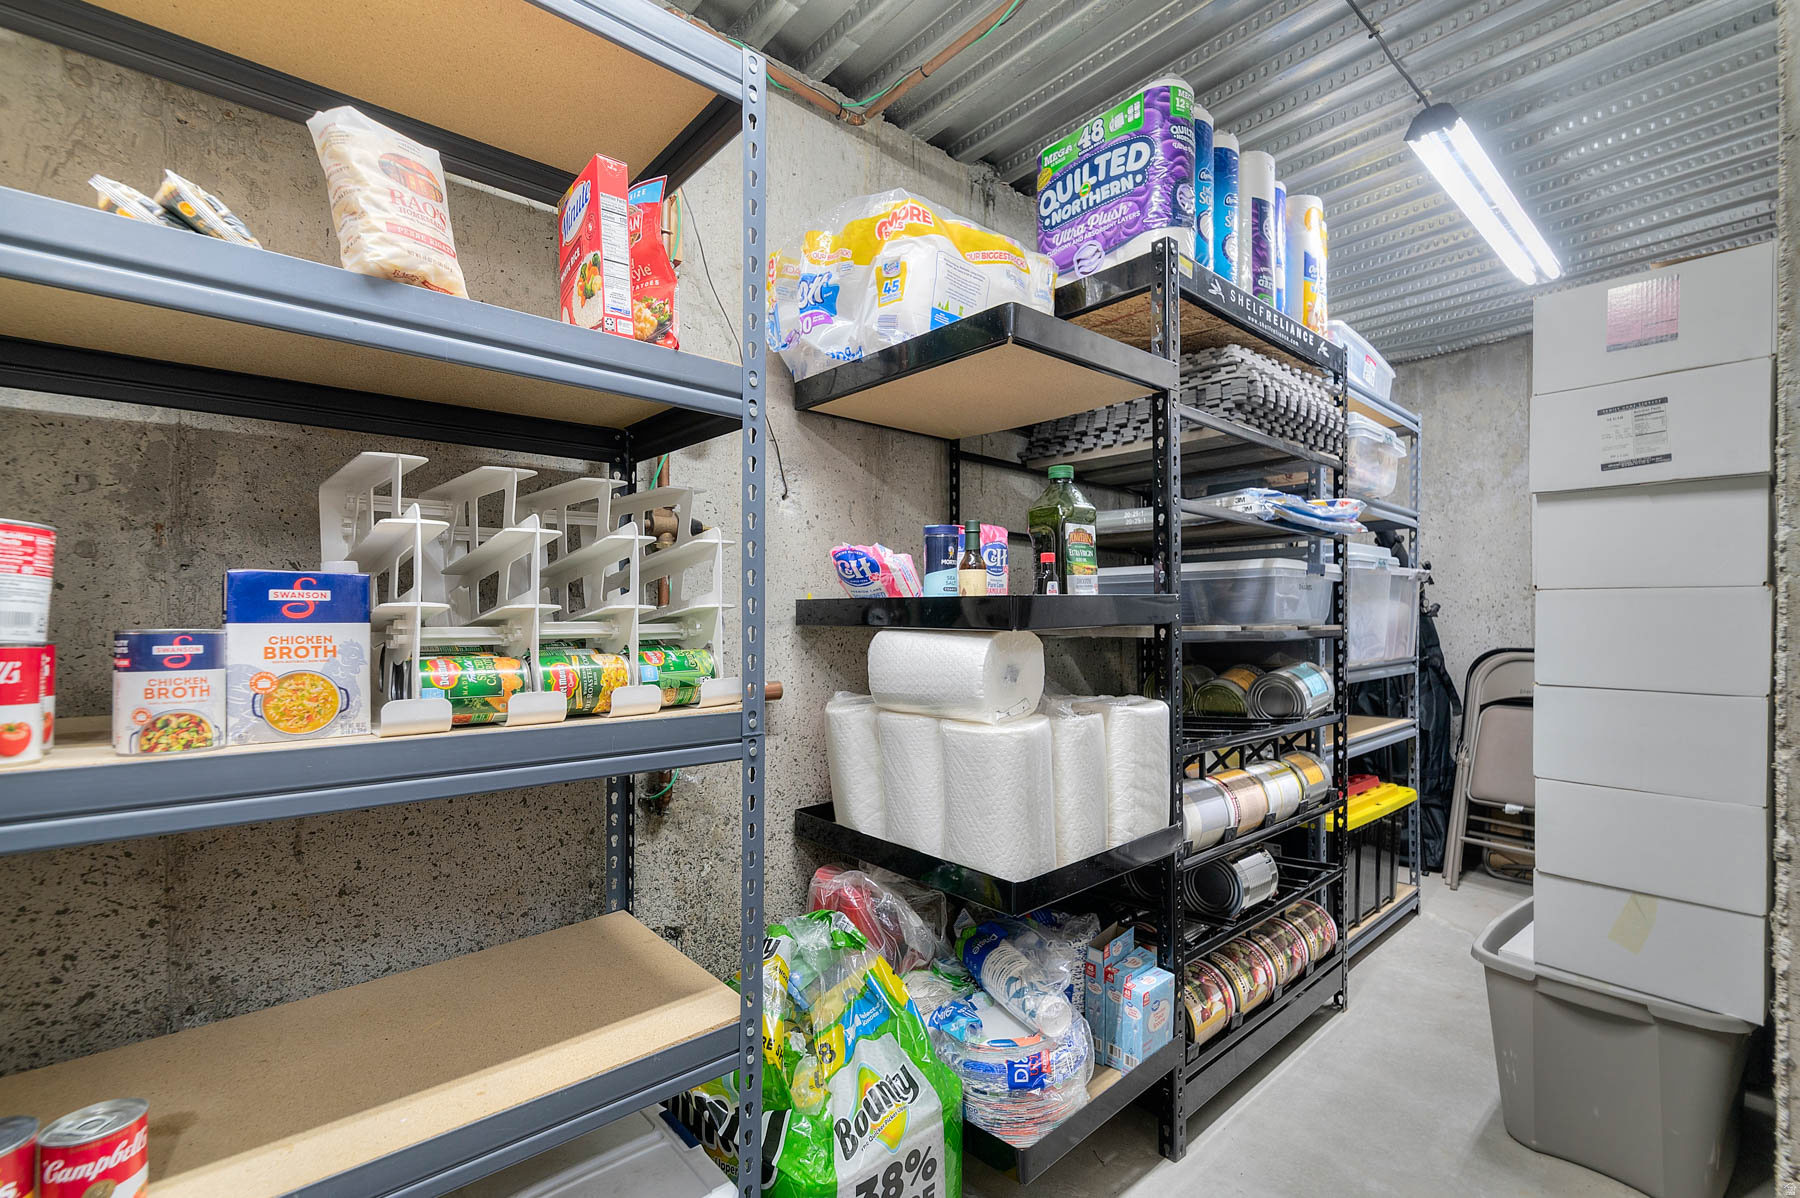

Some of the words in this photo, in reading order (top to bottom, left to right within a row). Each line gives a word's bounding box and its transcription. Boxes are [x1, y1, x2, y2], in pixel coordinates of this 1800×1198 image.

[1175, 97, 1185, 108] 12
[1076, 117, 1105, 148] 48
[1170, 126, 1195, 138] QUILT
[1044, 144, 1073, 167] MEGA
[1039, 141, 1151, 217] QUILTED
[629, 188, 647, 201] SIZE
[1051, 173, 1135, 226] NORTHERN
[388, 187, 447, 231] RAO'S
[563, 180, 591, 241] Minute
[1117, 210, 1141, 224] LAYERS
[1052, 222, 1087, 247] Ultra
[1087, 201, 1131, 231] Plush
[631, 263, 652, 282] tyle
[882, 279, 900, 295] 45
[1230, 289, 1315, 346] SHELFRELIANCE
[272, 591, 328, 600] SWANSON
[267, 635, 333, 646] CHICKEN
[155, 646, 202, 654] SWANSON
[263, 645, 338, 660] BROTH
[147, 676, 209, 688] CHICKEN
[143, 684, 211, 700] BROTH
[833, 1063, 920, 1162] Bounty
[883, 1111, 898, 1127] Picker
